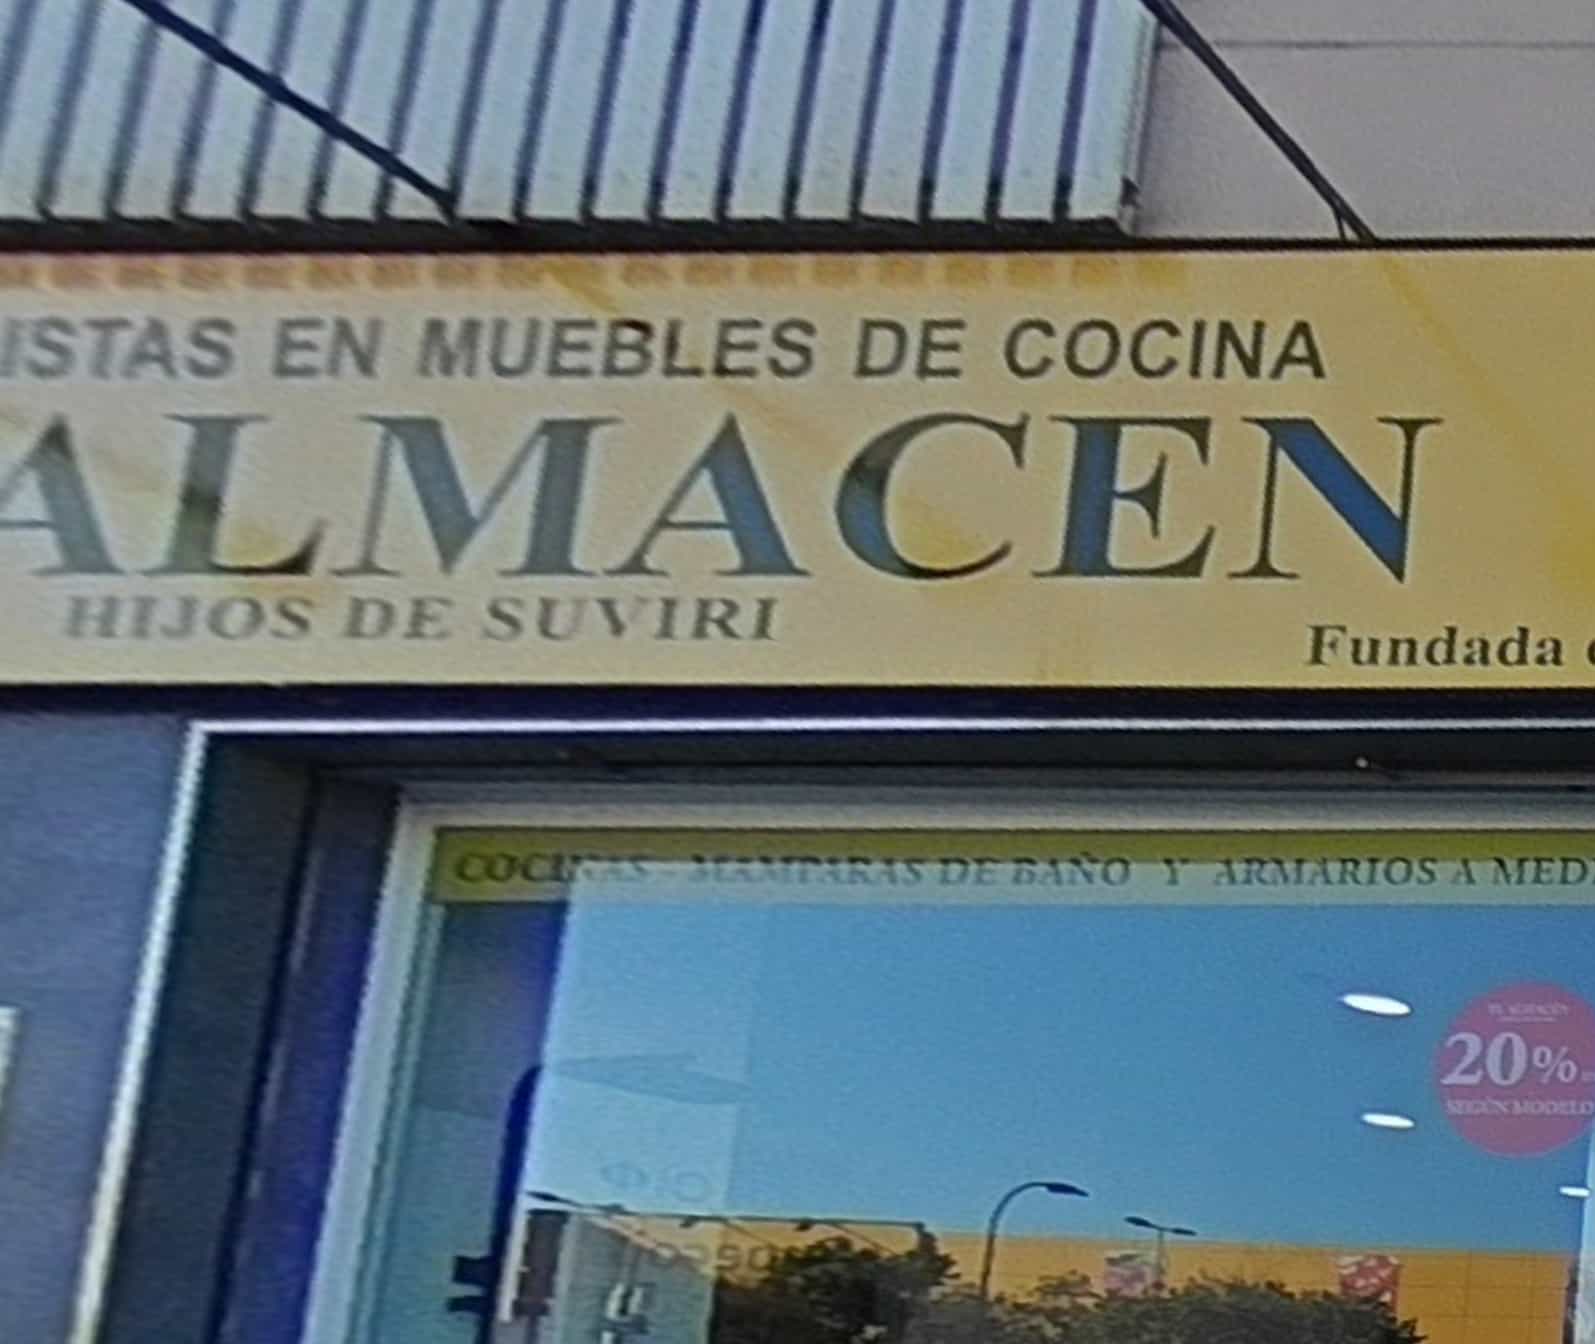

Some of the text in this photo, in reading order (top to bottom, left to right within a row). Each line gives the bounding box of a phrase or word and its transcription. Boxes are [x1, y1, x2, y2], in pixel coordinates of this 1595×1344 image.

[0, 316, 1326, 380] ISTAS EN MUEBLES DE COCINA
[0, 411, 1443, 582] ALMACEN
[64, 596, 778, 641] HIJOS DE SUVIRI
[1307, 624, 1563, 668] Fundada
[938, 855, 1002, 886] DE
[1011, 851, 1132, 886] BAÑO
[1163, 856, 1190, 886] Y
[1213, 857, 1438, 887] ARMARIOS
[1452, 858, 1479, 886] A
[1440, 1031, 1578, 1087] 20%
